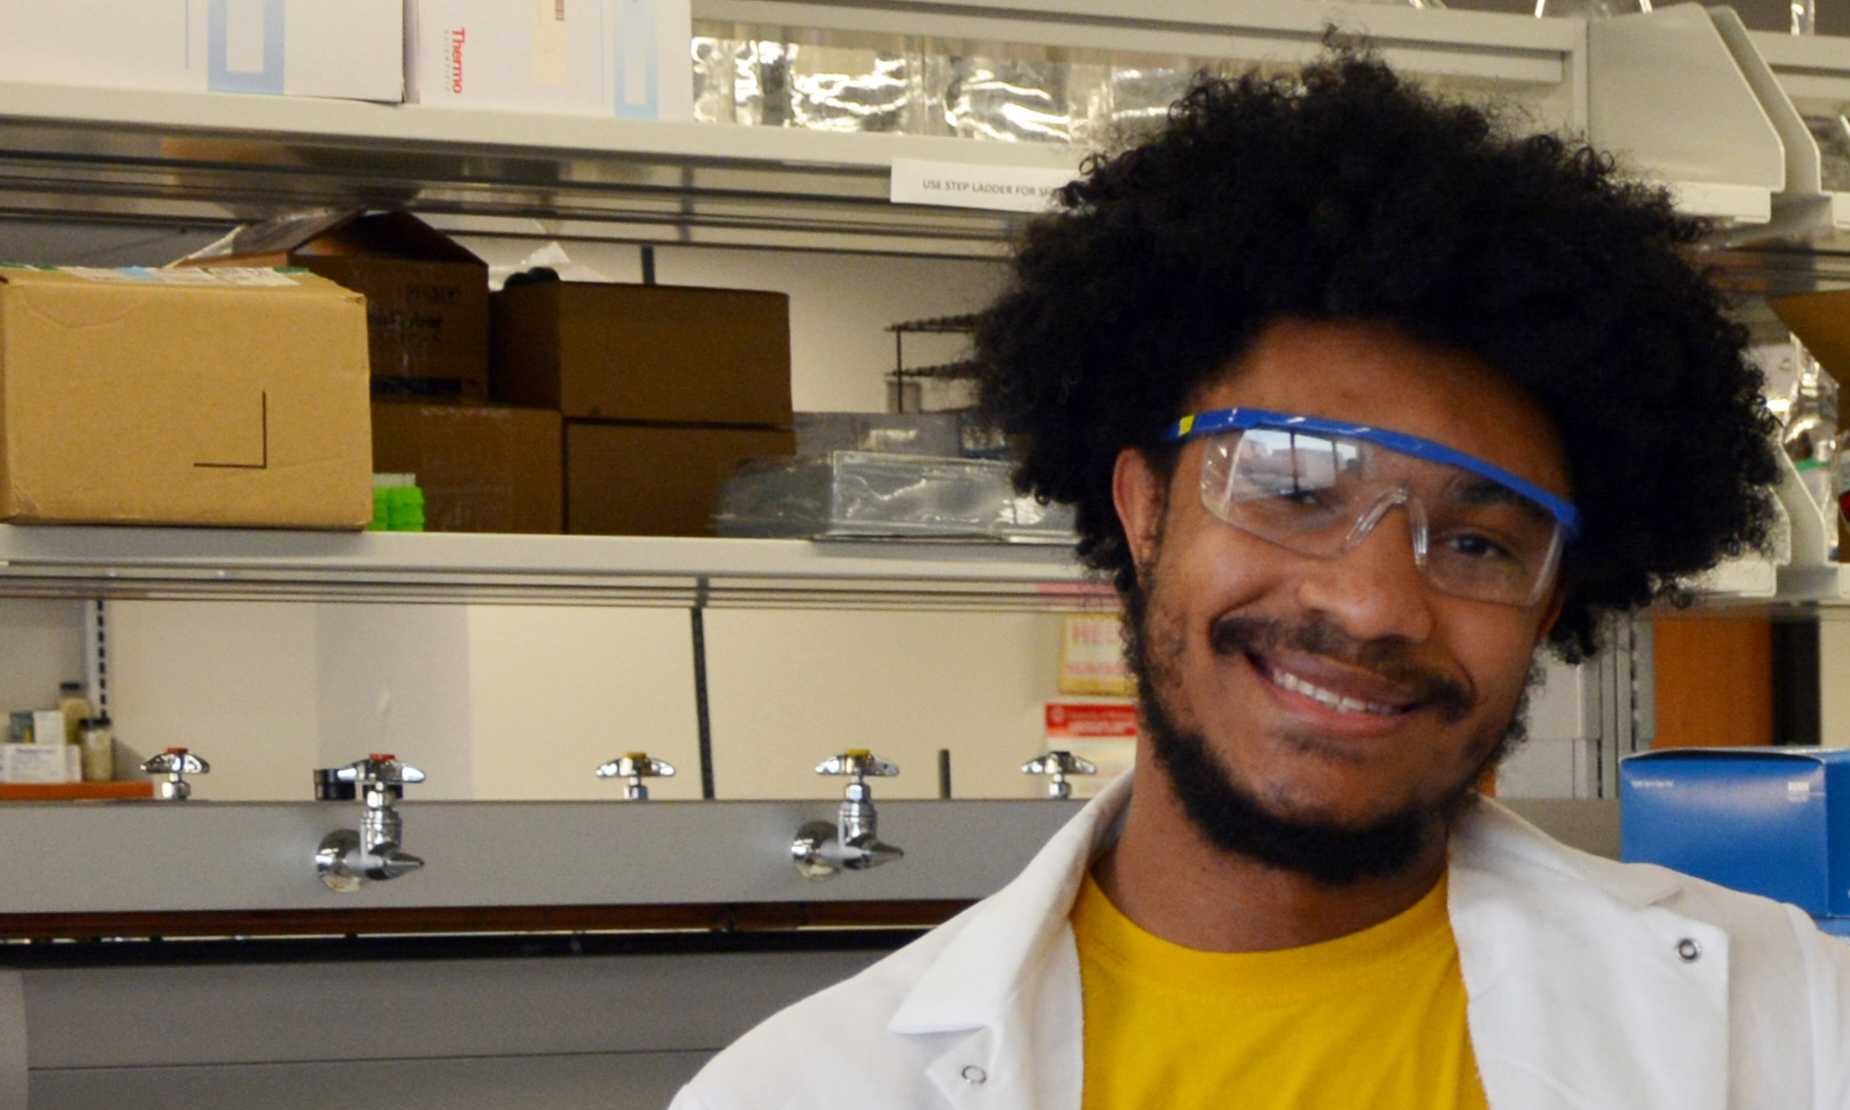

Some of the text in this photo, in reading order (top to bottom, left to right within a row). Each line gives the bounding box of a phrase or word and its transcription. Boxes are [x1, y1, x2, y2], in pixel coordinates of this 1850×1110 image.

[452, 27, 465, 94] Thermo
[922, 179, 941, 190] USE
[945, 180, 969, 192] STEP
[972, 182, 1013, 194] LADDER
[1015, 186, 1036, 196] FOR
